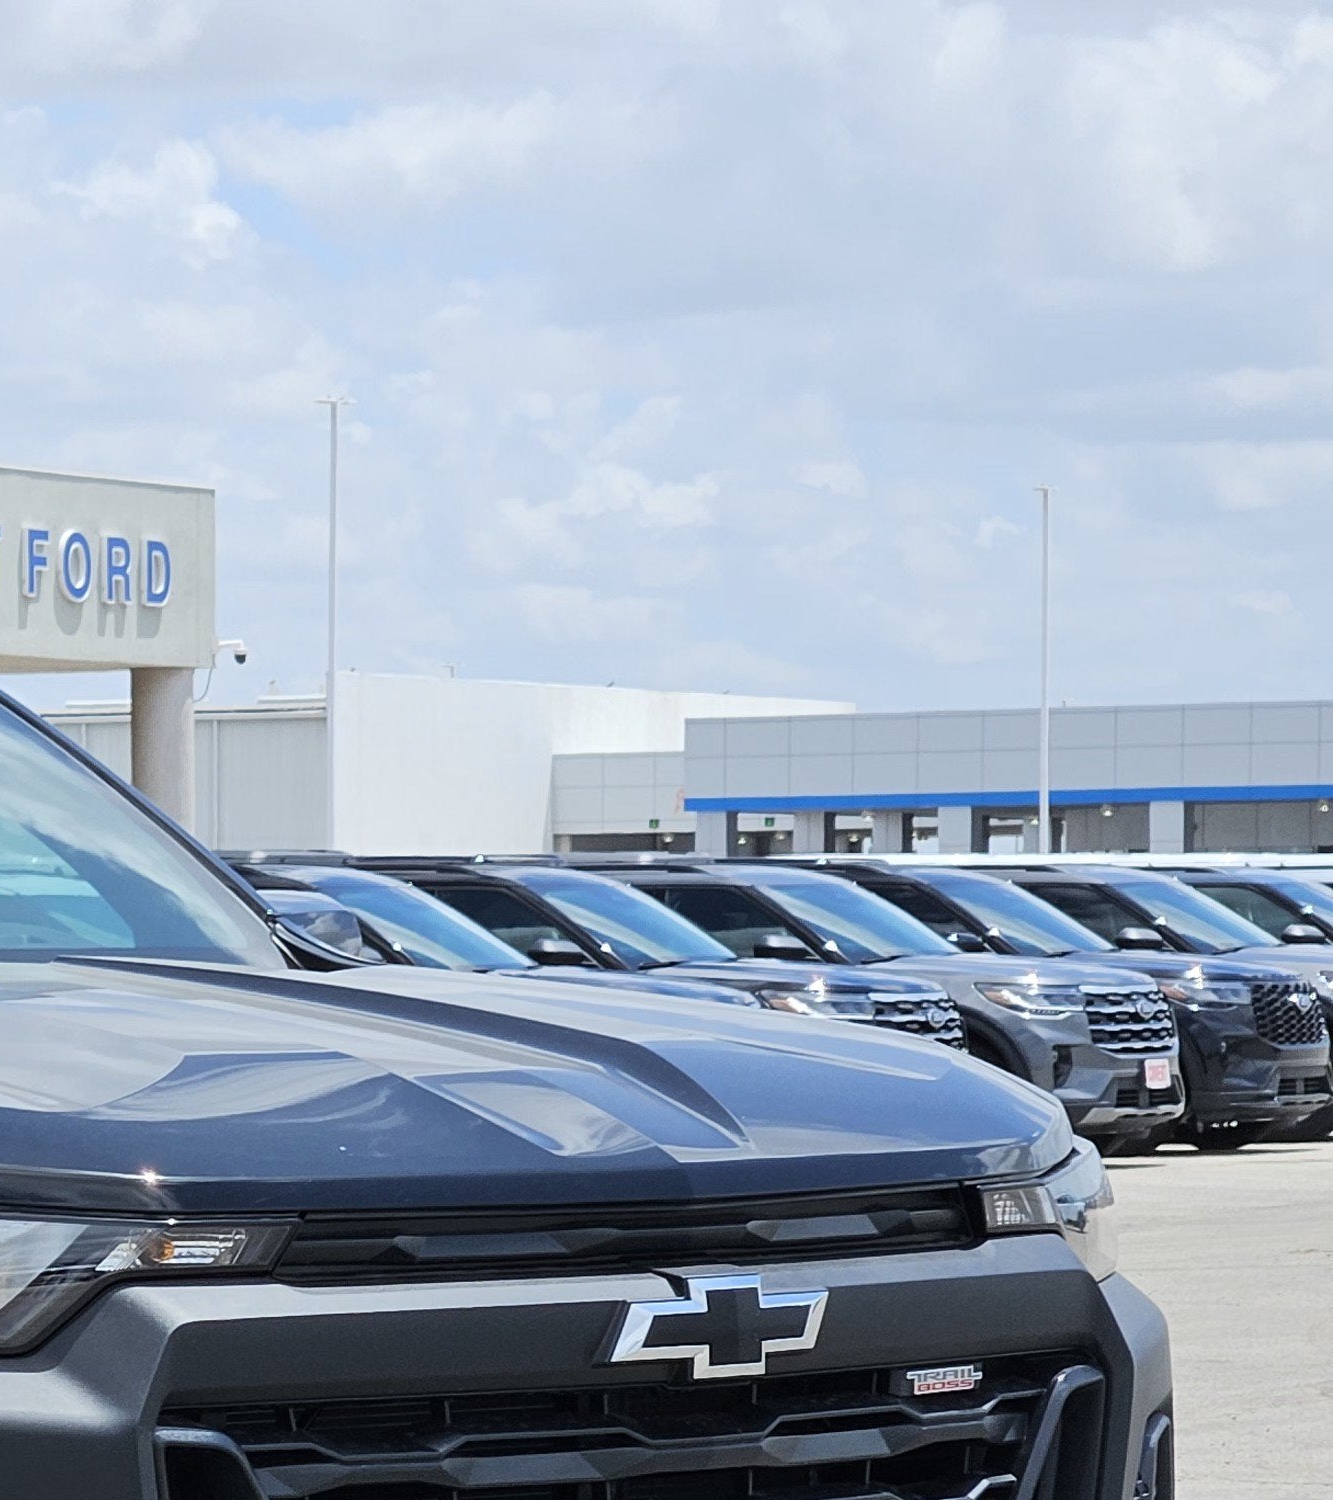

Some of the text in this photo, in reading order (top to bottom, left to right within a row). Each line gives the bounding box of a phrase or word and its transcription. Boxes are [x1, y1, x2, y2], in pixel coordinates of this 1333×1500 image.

[20, 526, 173, 607] FORD
[906, 1365, 983, 1383] TRAIL
[916, 1379, 974, 1394] BOSS
